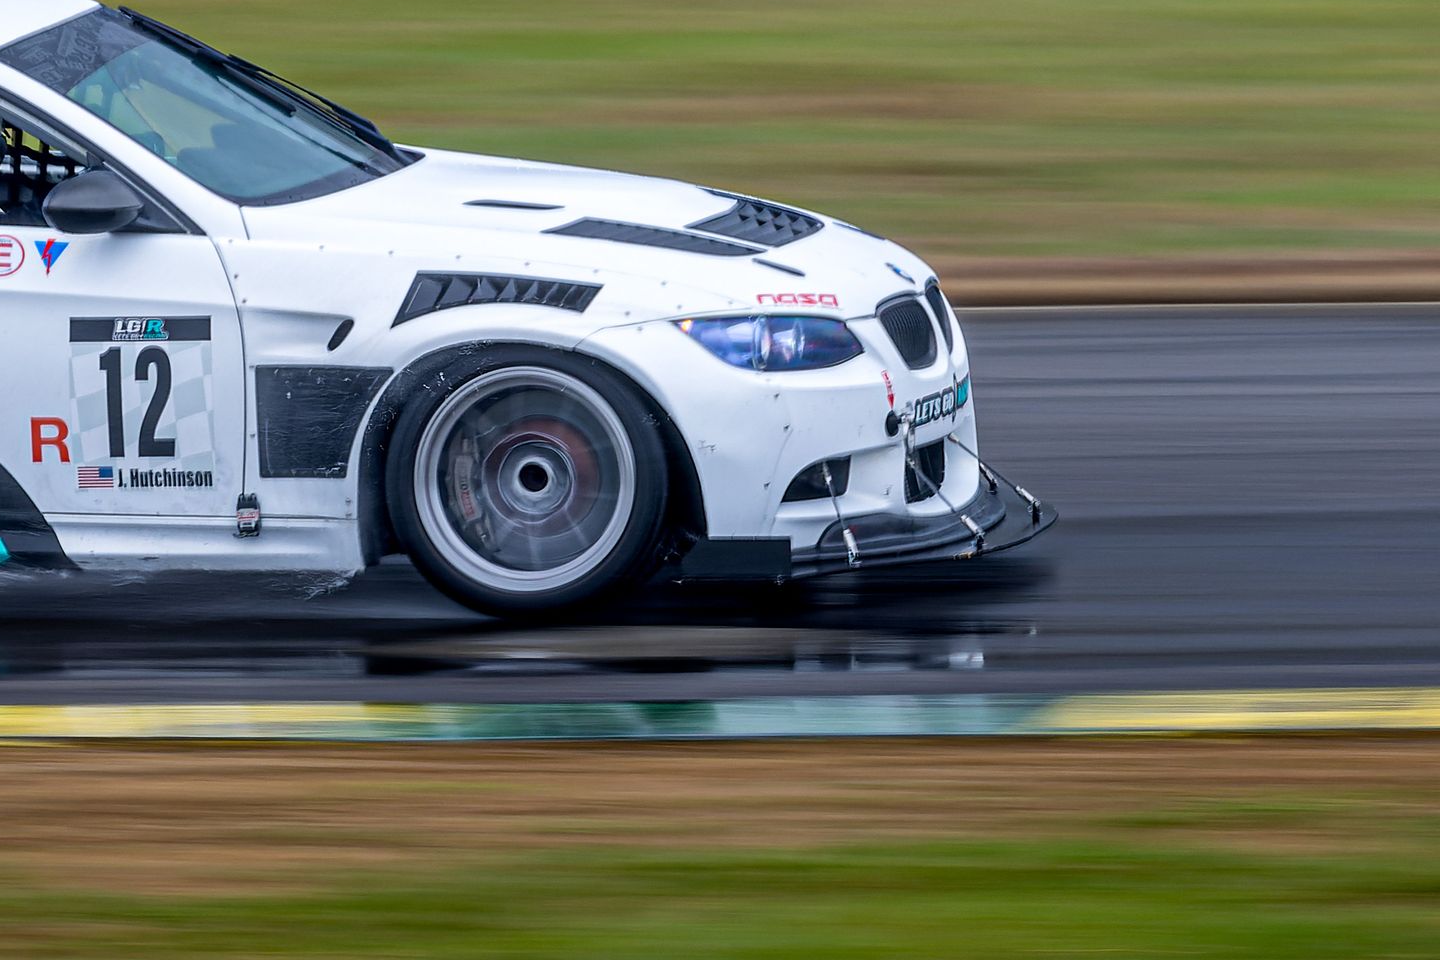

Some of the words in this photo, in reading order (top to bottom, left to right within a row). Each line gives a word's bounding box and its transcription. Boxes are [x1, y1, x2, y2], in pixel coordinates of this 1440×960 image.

[99, 345, 176, 458] 12
[30, 417, 71, 463] R
[118, 468, 127, 488] J.
[130, 468, 213, 488] Hutchinson
